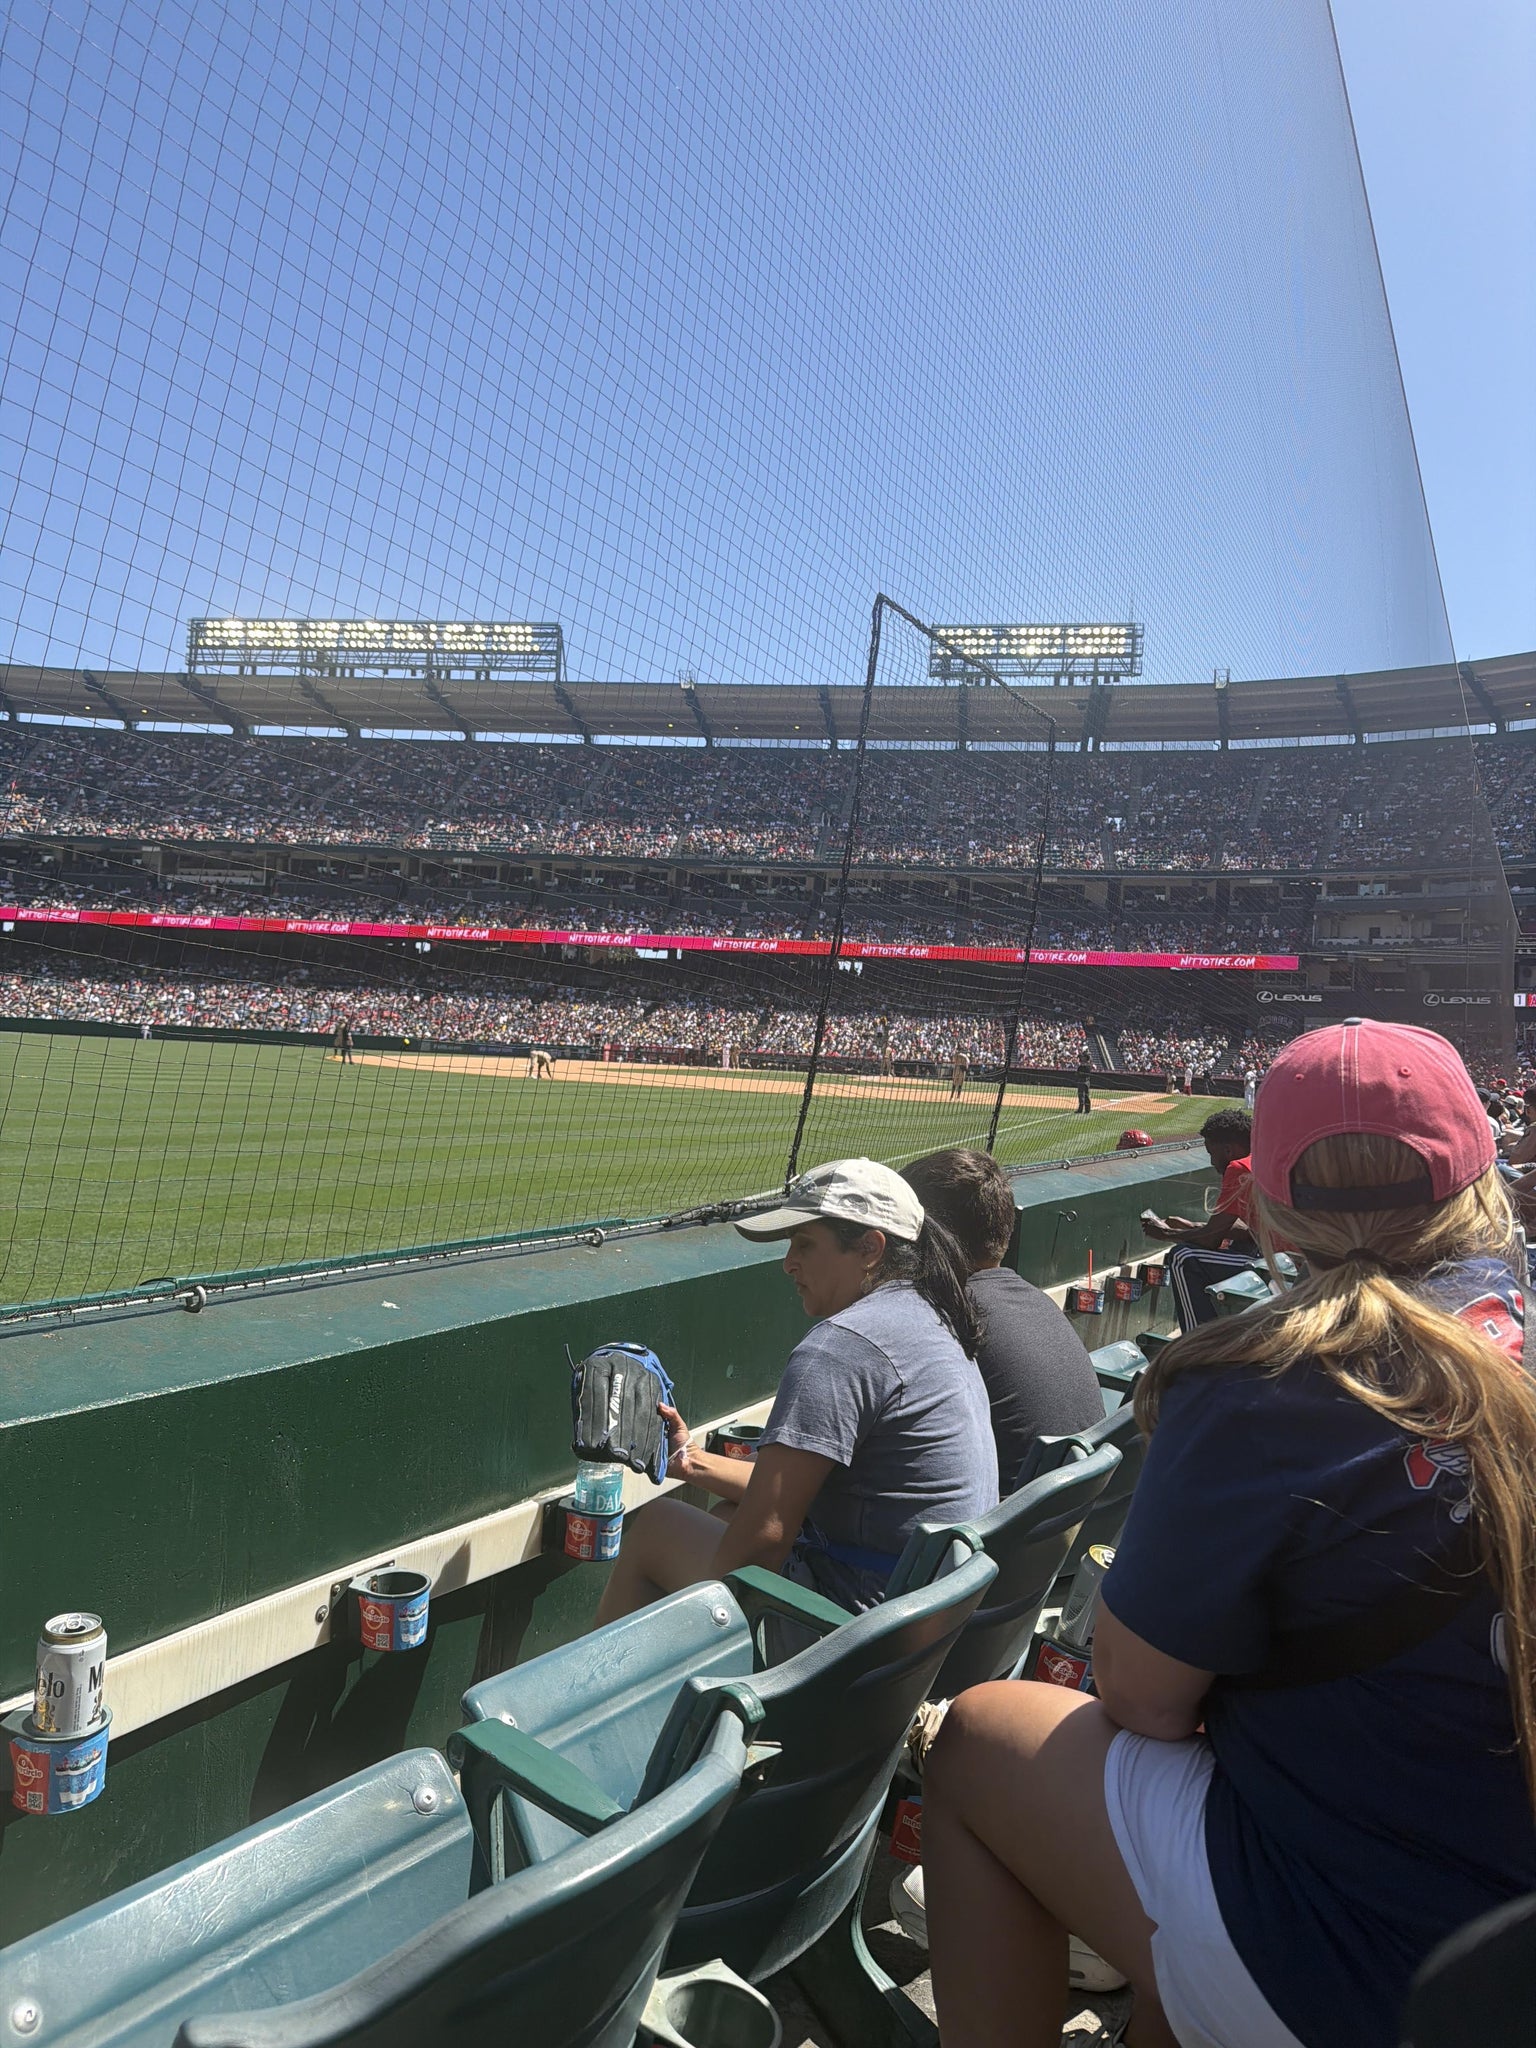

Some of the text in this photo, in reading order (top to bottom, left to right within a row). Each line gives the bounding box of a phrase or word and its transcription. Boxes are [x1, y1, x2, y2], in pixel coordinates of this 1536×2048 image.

[569, 934, 632, 945] NITTOTIRE.COM
[712, 940, 778, 951] NITTOTIRE.COM
[861, 945, 930, 957] NITTOTIRE.COM
[1016, 952, 1087, 963] NTTOTIRE.COM
[1180, 956, 1256, 968] NITTOTIRE.COM
[1274, 993, 1323, 1003] LEXUS
[1441, 996, 1492, 1005] LEXUS
